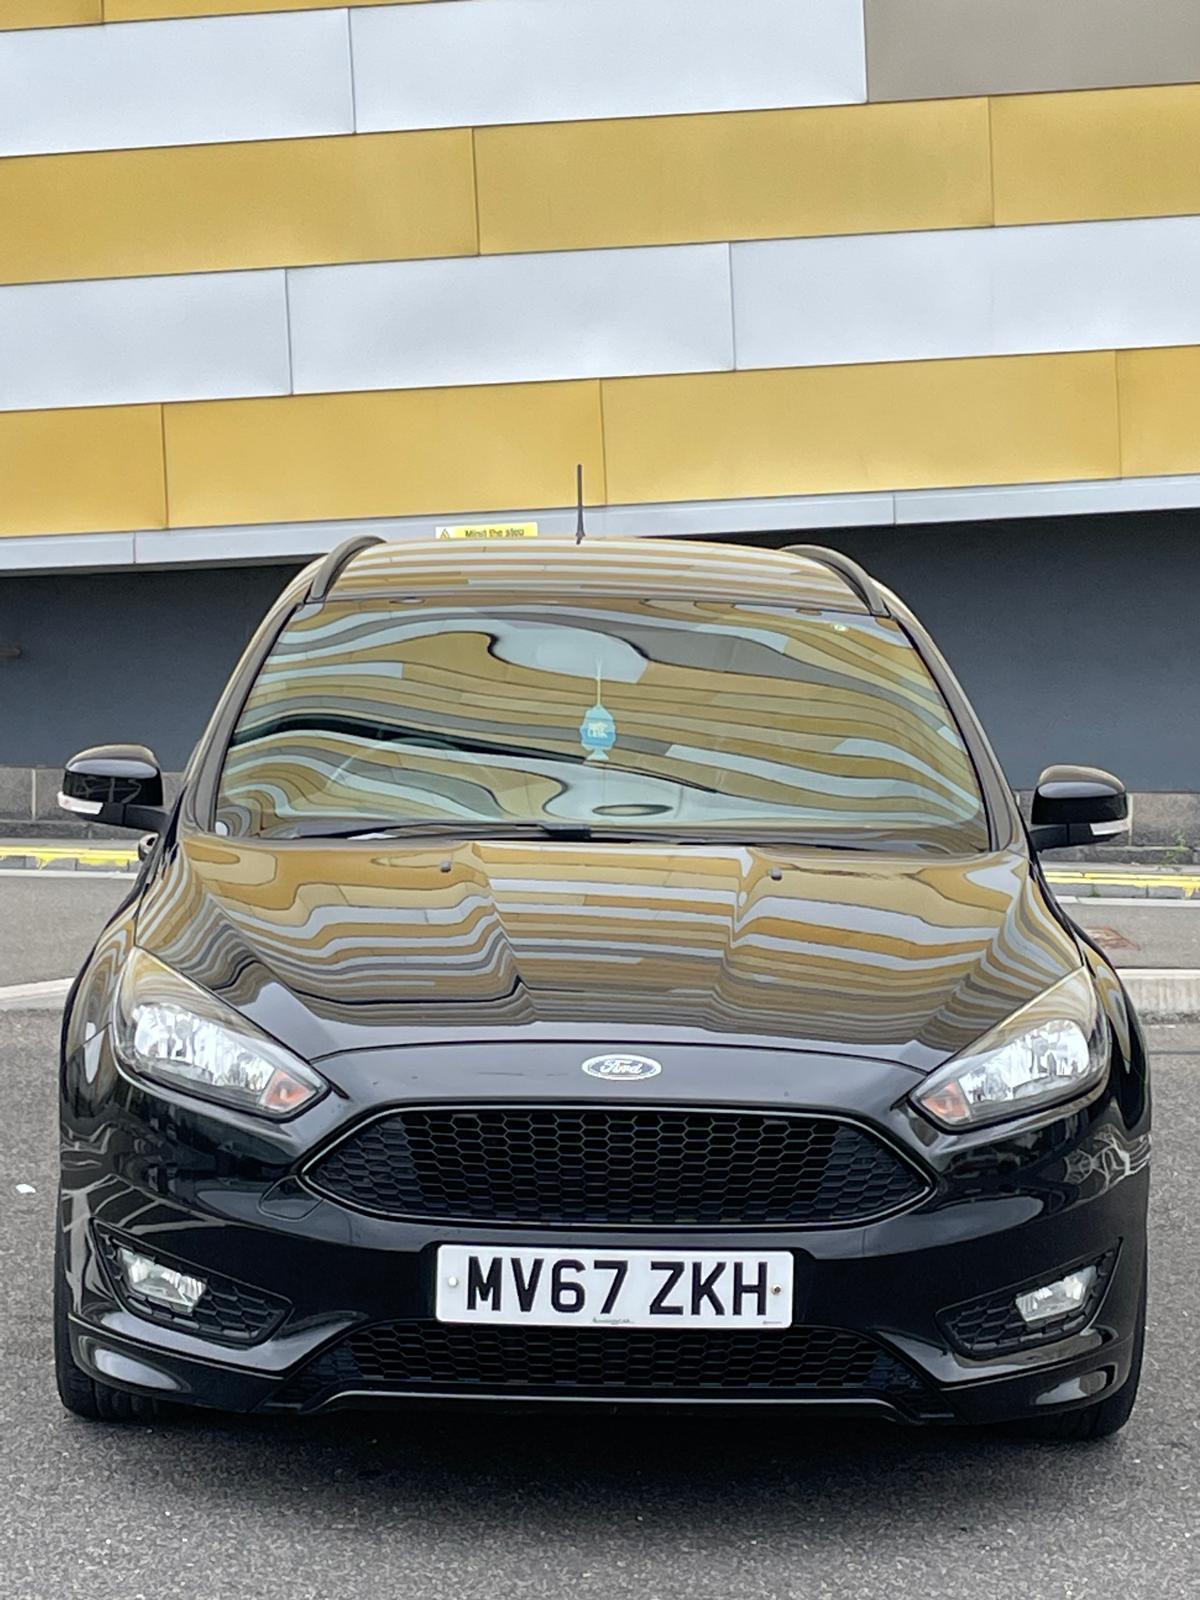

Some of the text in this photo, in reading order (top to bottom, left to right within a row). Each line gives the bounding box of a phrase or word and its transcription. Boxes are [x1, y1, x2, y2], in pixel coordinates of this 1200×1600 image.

[465, 528, 525, 538] Mind the step
[600, 1058, 643, 1074] Ford
[467, 1256, 768, 1316] MV67 ZKH
